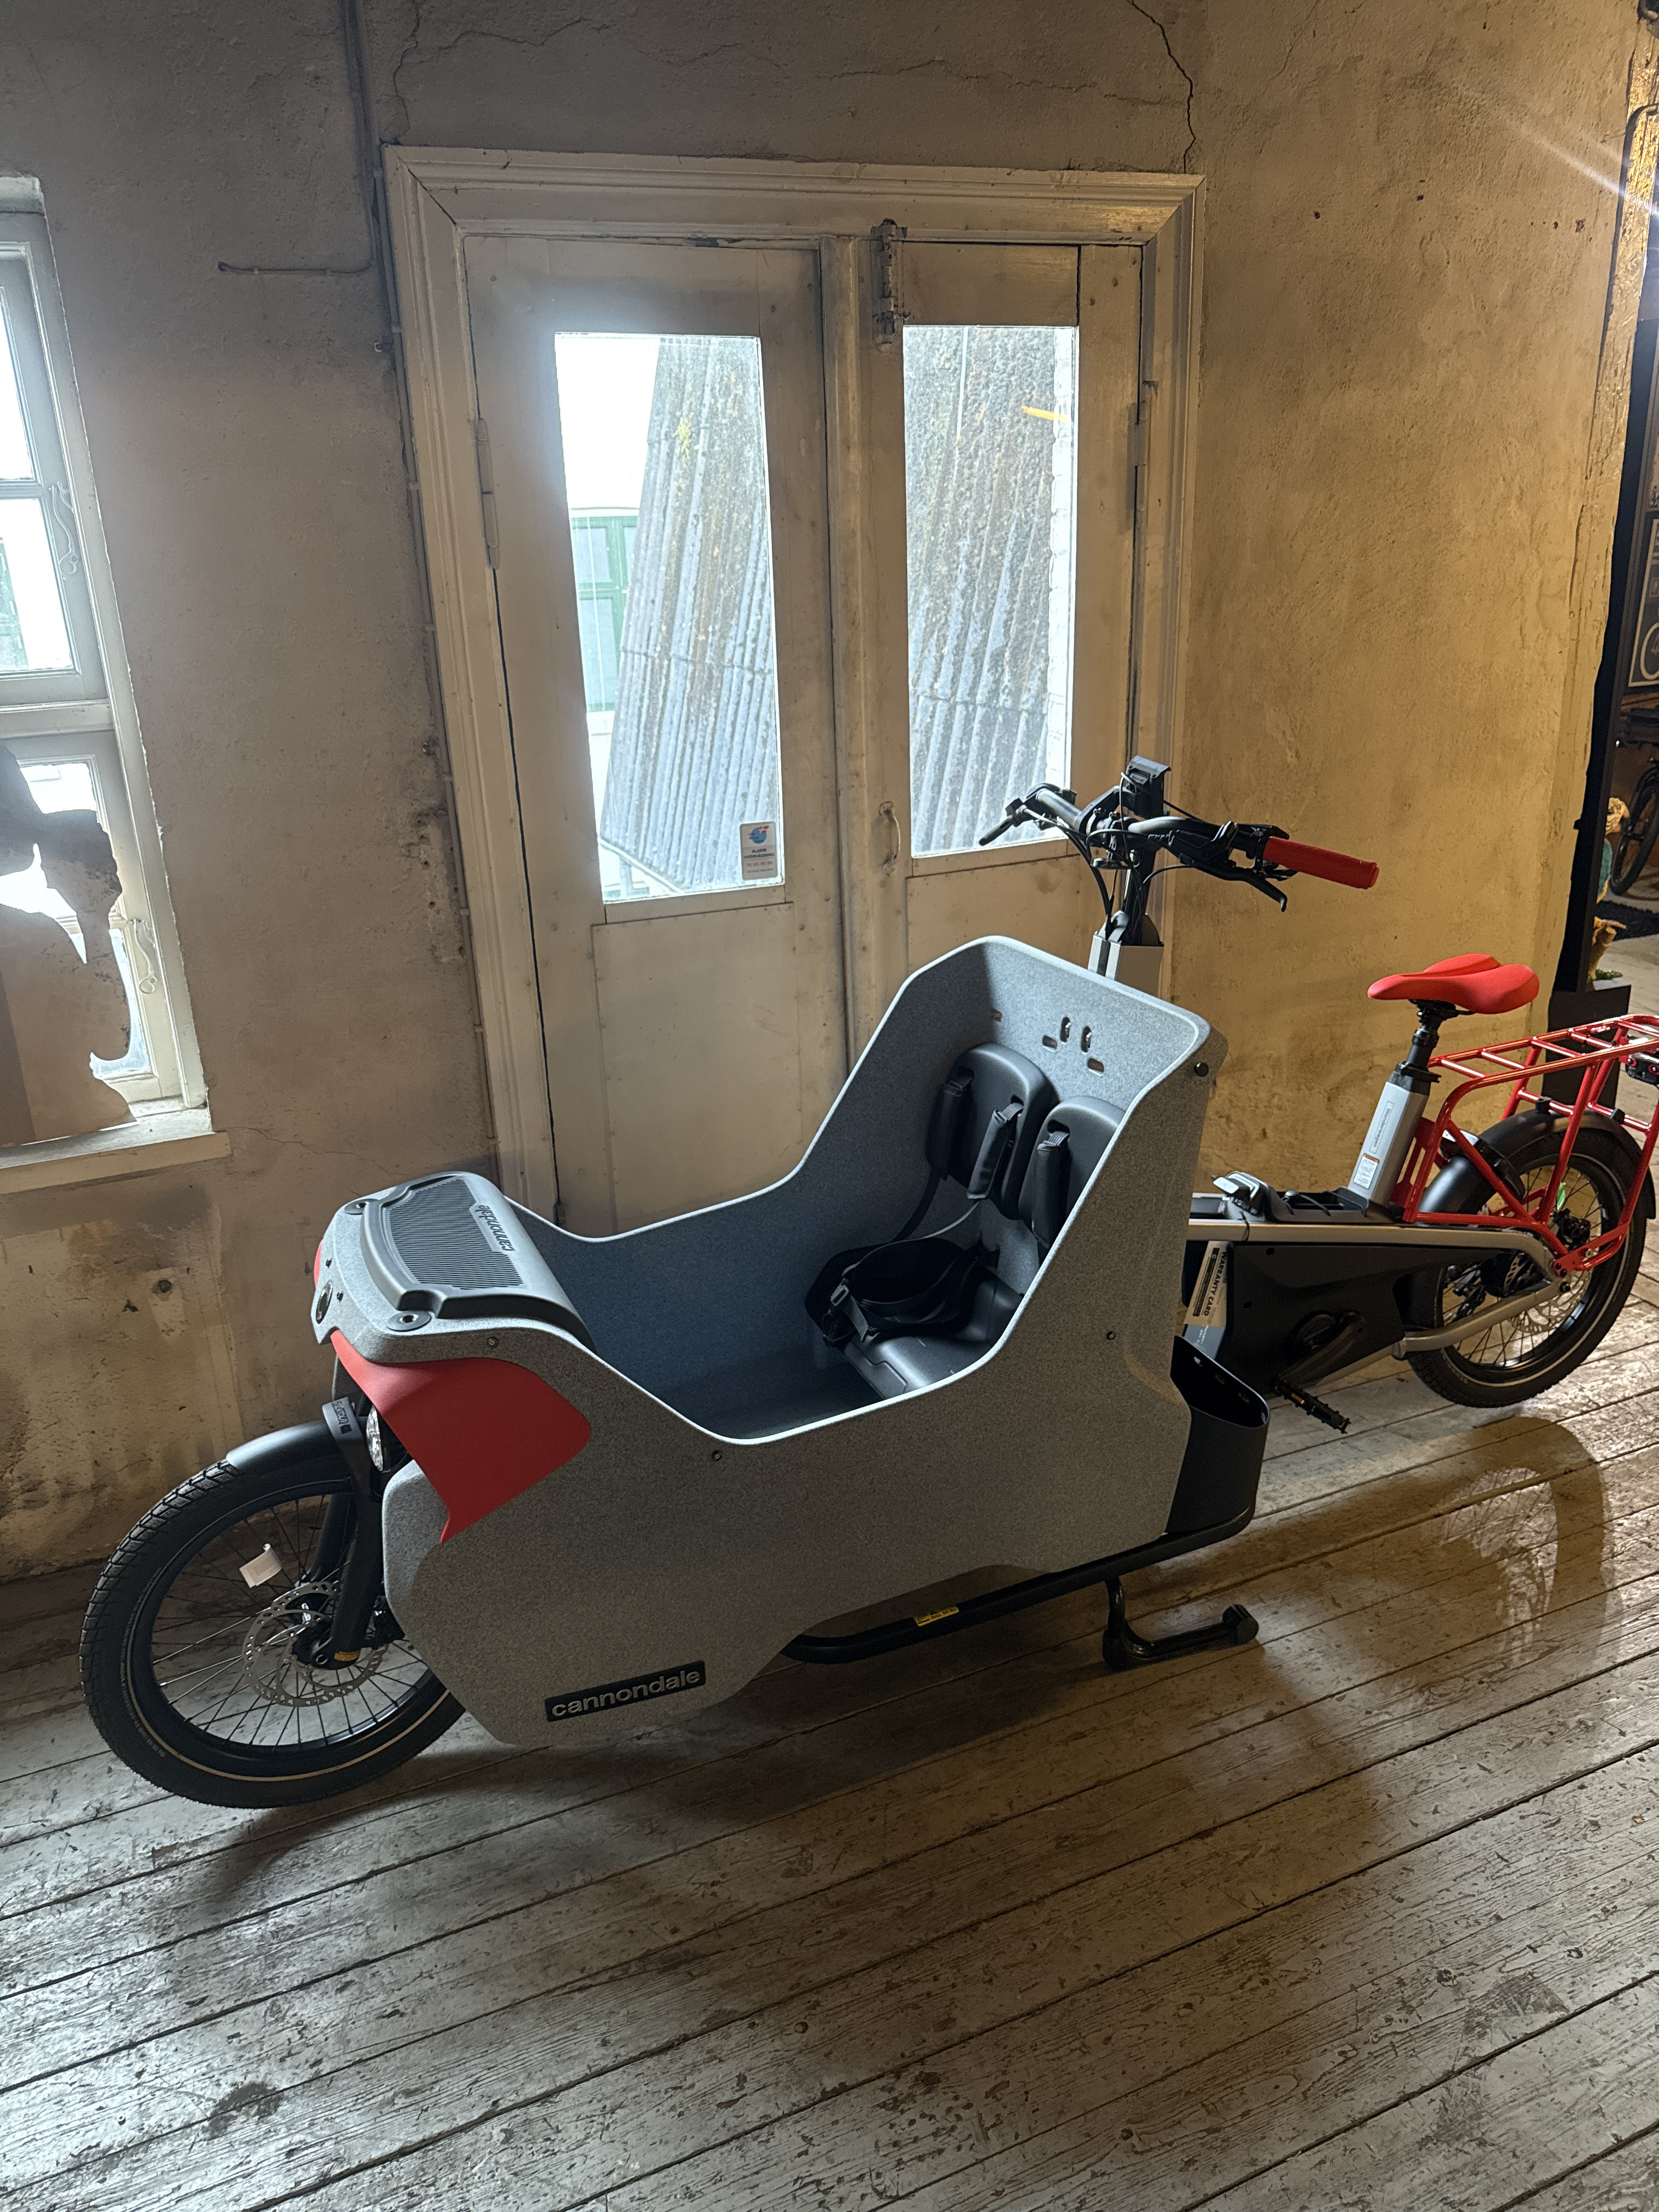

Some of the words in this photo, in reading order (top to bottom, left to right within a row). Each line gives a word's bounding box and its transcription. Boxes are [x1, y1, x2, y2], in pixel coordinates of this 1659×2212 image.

[1373, 1108, 1391, 1147] Wonderwagen
[475, 1205, 515, 1251] cannondale
[1210, 1251, 1228, 1296] WARRANTY
[1204, 1296, 1214, 1316] CARD
[551, 1670, 701, 1717] cannondale
